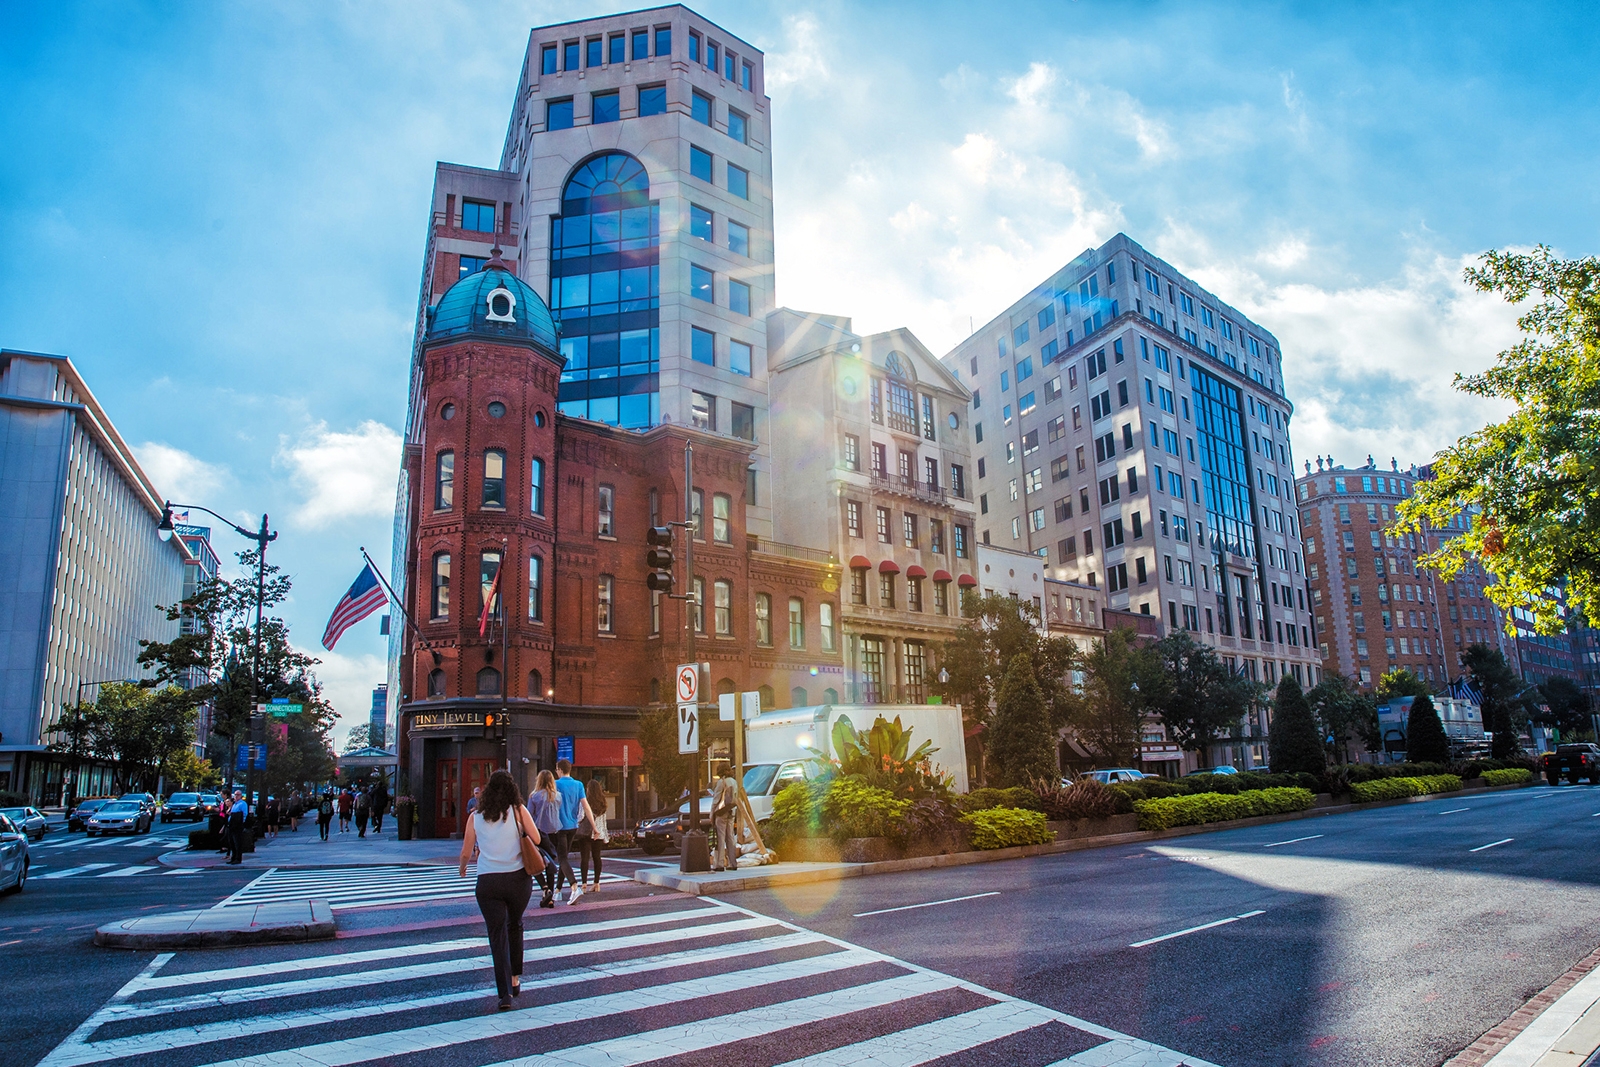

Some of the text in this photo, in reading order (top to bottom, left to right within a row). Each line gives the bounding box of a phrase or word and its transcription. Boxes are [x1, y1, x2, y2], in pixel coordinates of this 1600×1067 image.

[266, 704, 297, 712] CONNECTICUT
[415, 714, 438, 725] TINY
[444, 712, 481, 729] JEWEL
